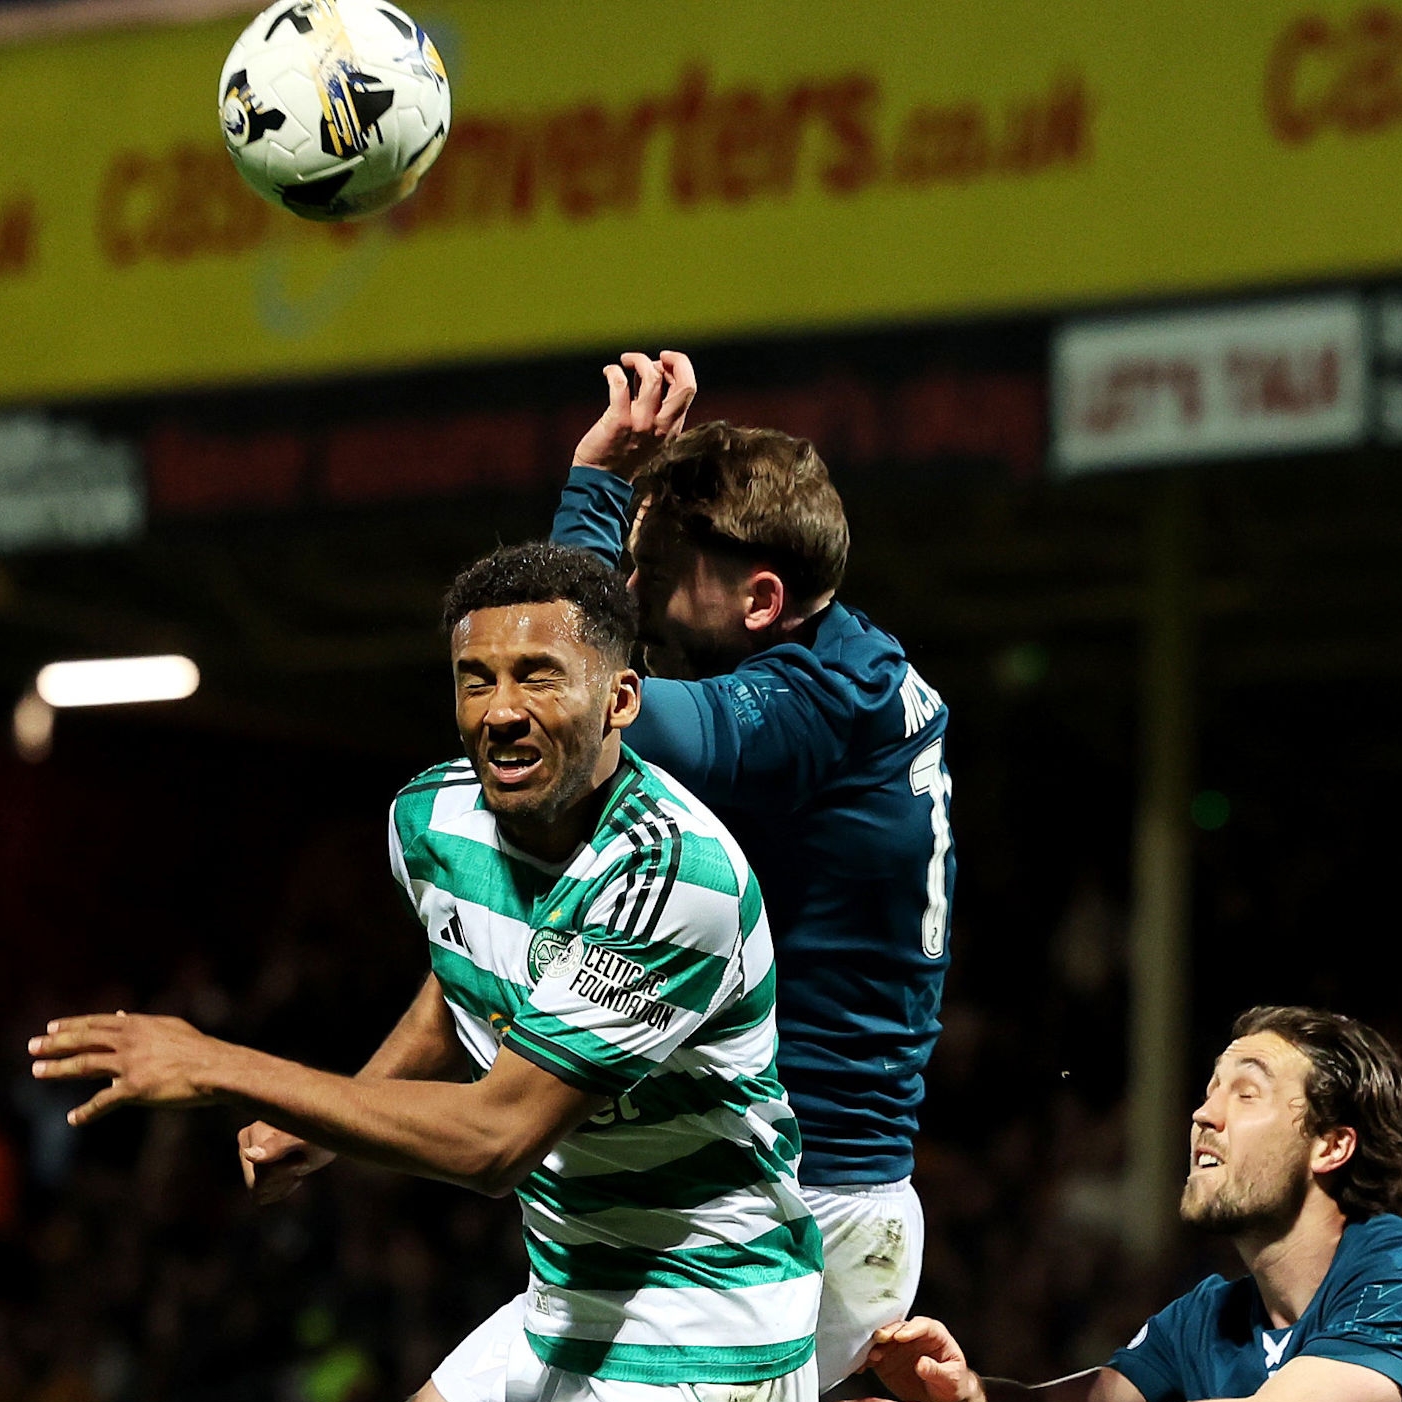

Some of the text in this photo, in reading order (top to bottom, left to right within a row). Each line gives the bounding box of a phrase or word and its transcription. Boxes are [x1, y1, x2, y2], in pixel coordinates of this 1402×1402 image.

[909, 737, 952, 959] 1
[584, 944, 667, 997] CELTIC FC
